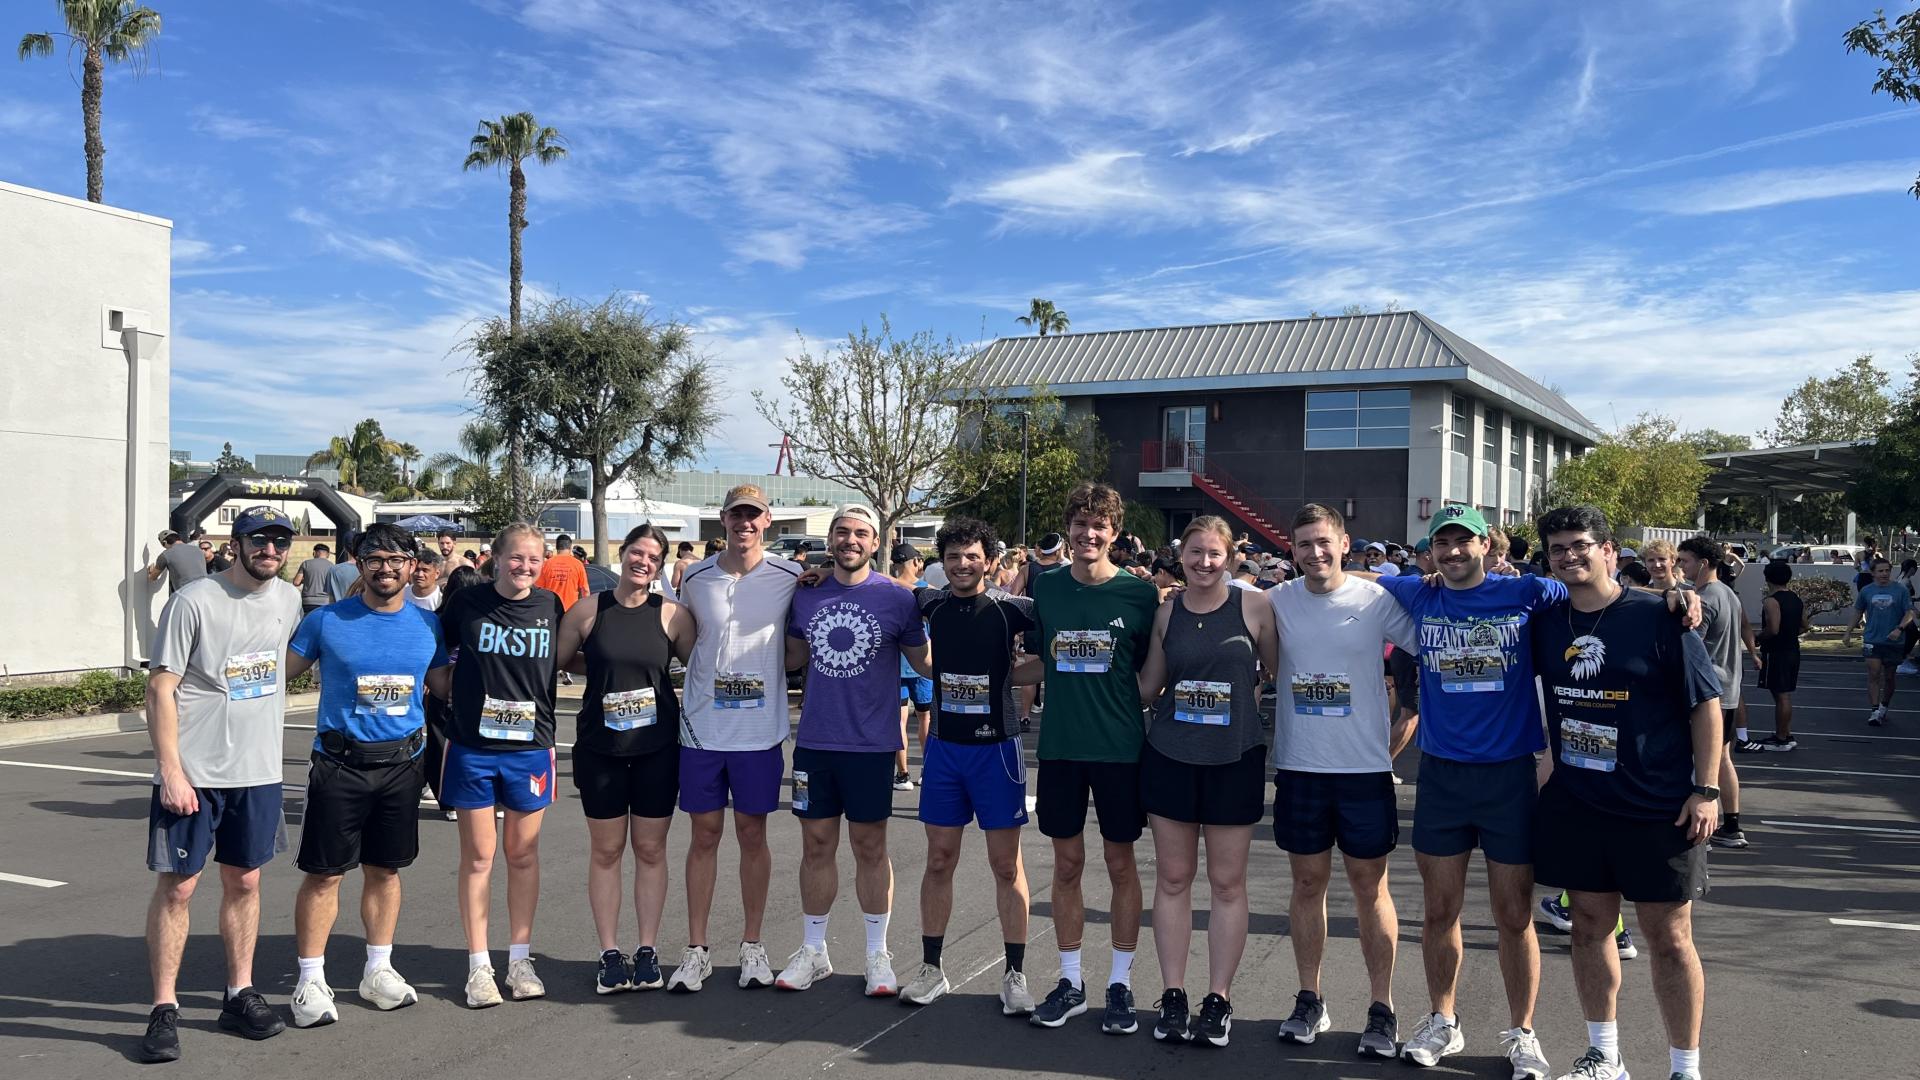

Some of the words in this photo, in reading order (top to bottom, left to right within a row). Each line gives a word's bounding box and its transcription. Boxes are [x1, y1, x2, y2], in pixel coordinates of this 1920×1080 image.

[249, 483, 300, 496] START
[840, 602, 860, 612] FOR
[478, 622, 550, 659] BKSTR
[866, 613, 882, 660] CATHOLIC
[1069, 643, 1097, 658] 605
[241, 664, 270, 682] 392
[813, 660, 865, 679] EDUCATION
[1454, 661, 1485, 676] 542
[373, 687, 400, 702] 276
[725, 683, 751, 696] 436
[951, 686, 976, 700] 529
[1305, 685, 1335, 701] 469
[1187, 693, 1216, 709] 460
[617, 701, 642, 717] 513
[494, 712, 522, 726] 442
[1570, 734, 1600, 755] 535
